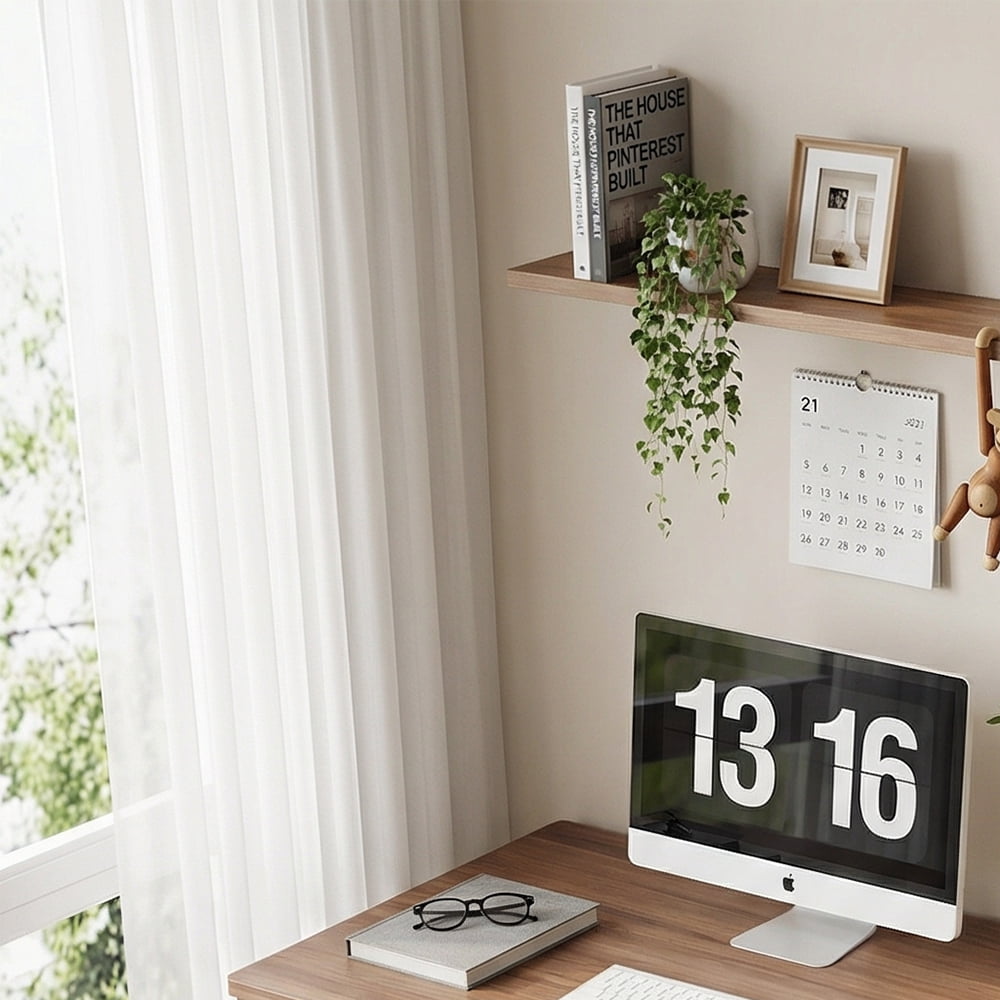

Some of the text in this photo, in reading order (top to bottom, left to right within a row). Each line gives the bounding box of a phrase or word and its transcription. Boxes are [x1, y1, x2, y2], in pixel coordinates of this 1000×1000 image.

[605, 88, 685, 123] THE HOUSE
[606, 120, 643, 146] THAT
[607, 133, 685, 170] PINTEREST
[608, 165, 648, 193] BUILT
[801, 397, 818, 413] 21
[860, 444, 922, 463] 1 2 3 4
[803, 459, 923, 489] 5 6 7 8 9 10 11
[802, 484, 924, 515] 12 13 14 15 16 17 18
[801, 508, 923, 540] 19 20 21 22 23 24 25
[800, 533, 812, 544] 26
[819, 536, 831, 547] 27
[837, 540, 849, 551] 28
[855, 543, 868, 554] 29
[675, 678, 918, 841] 13 16
